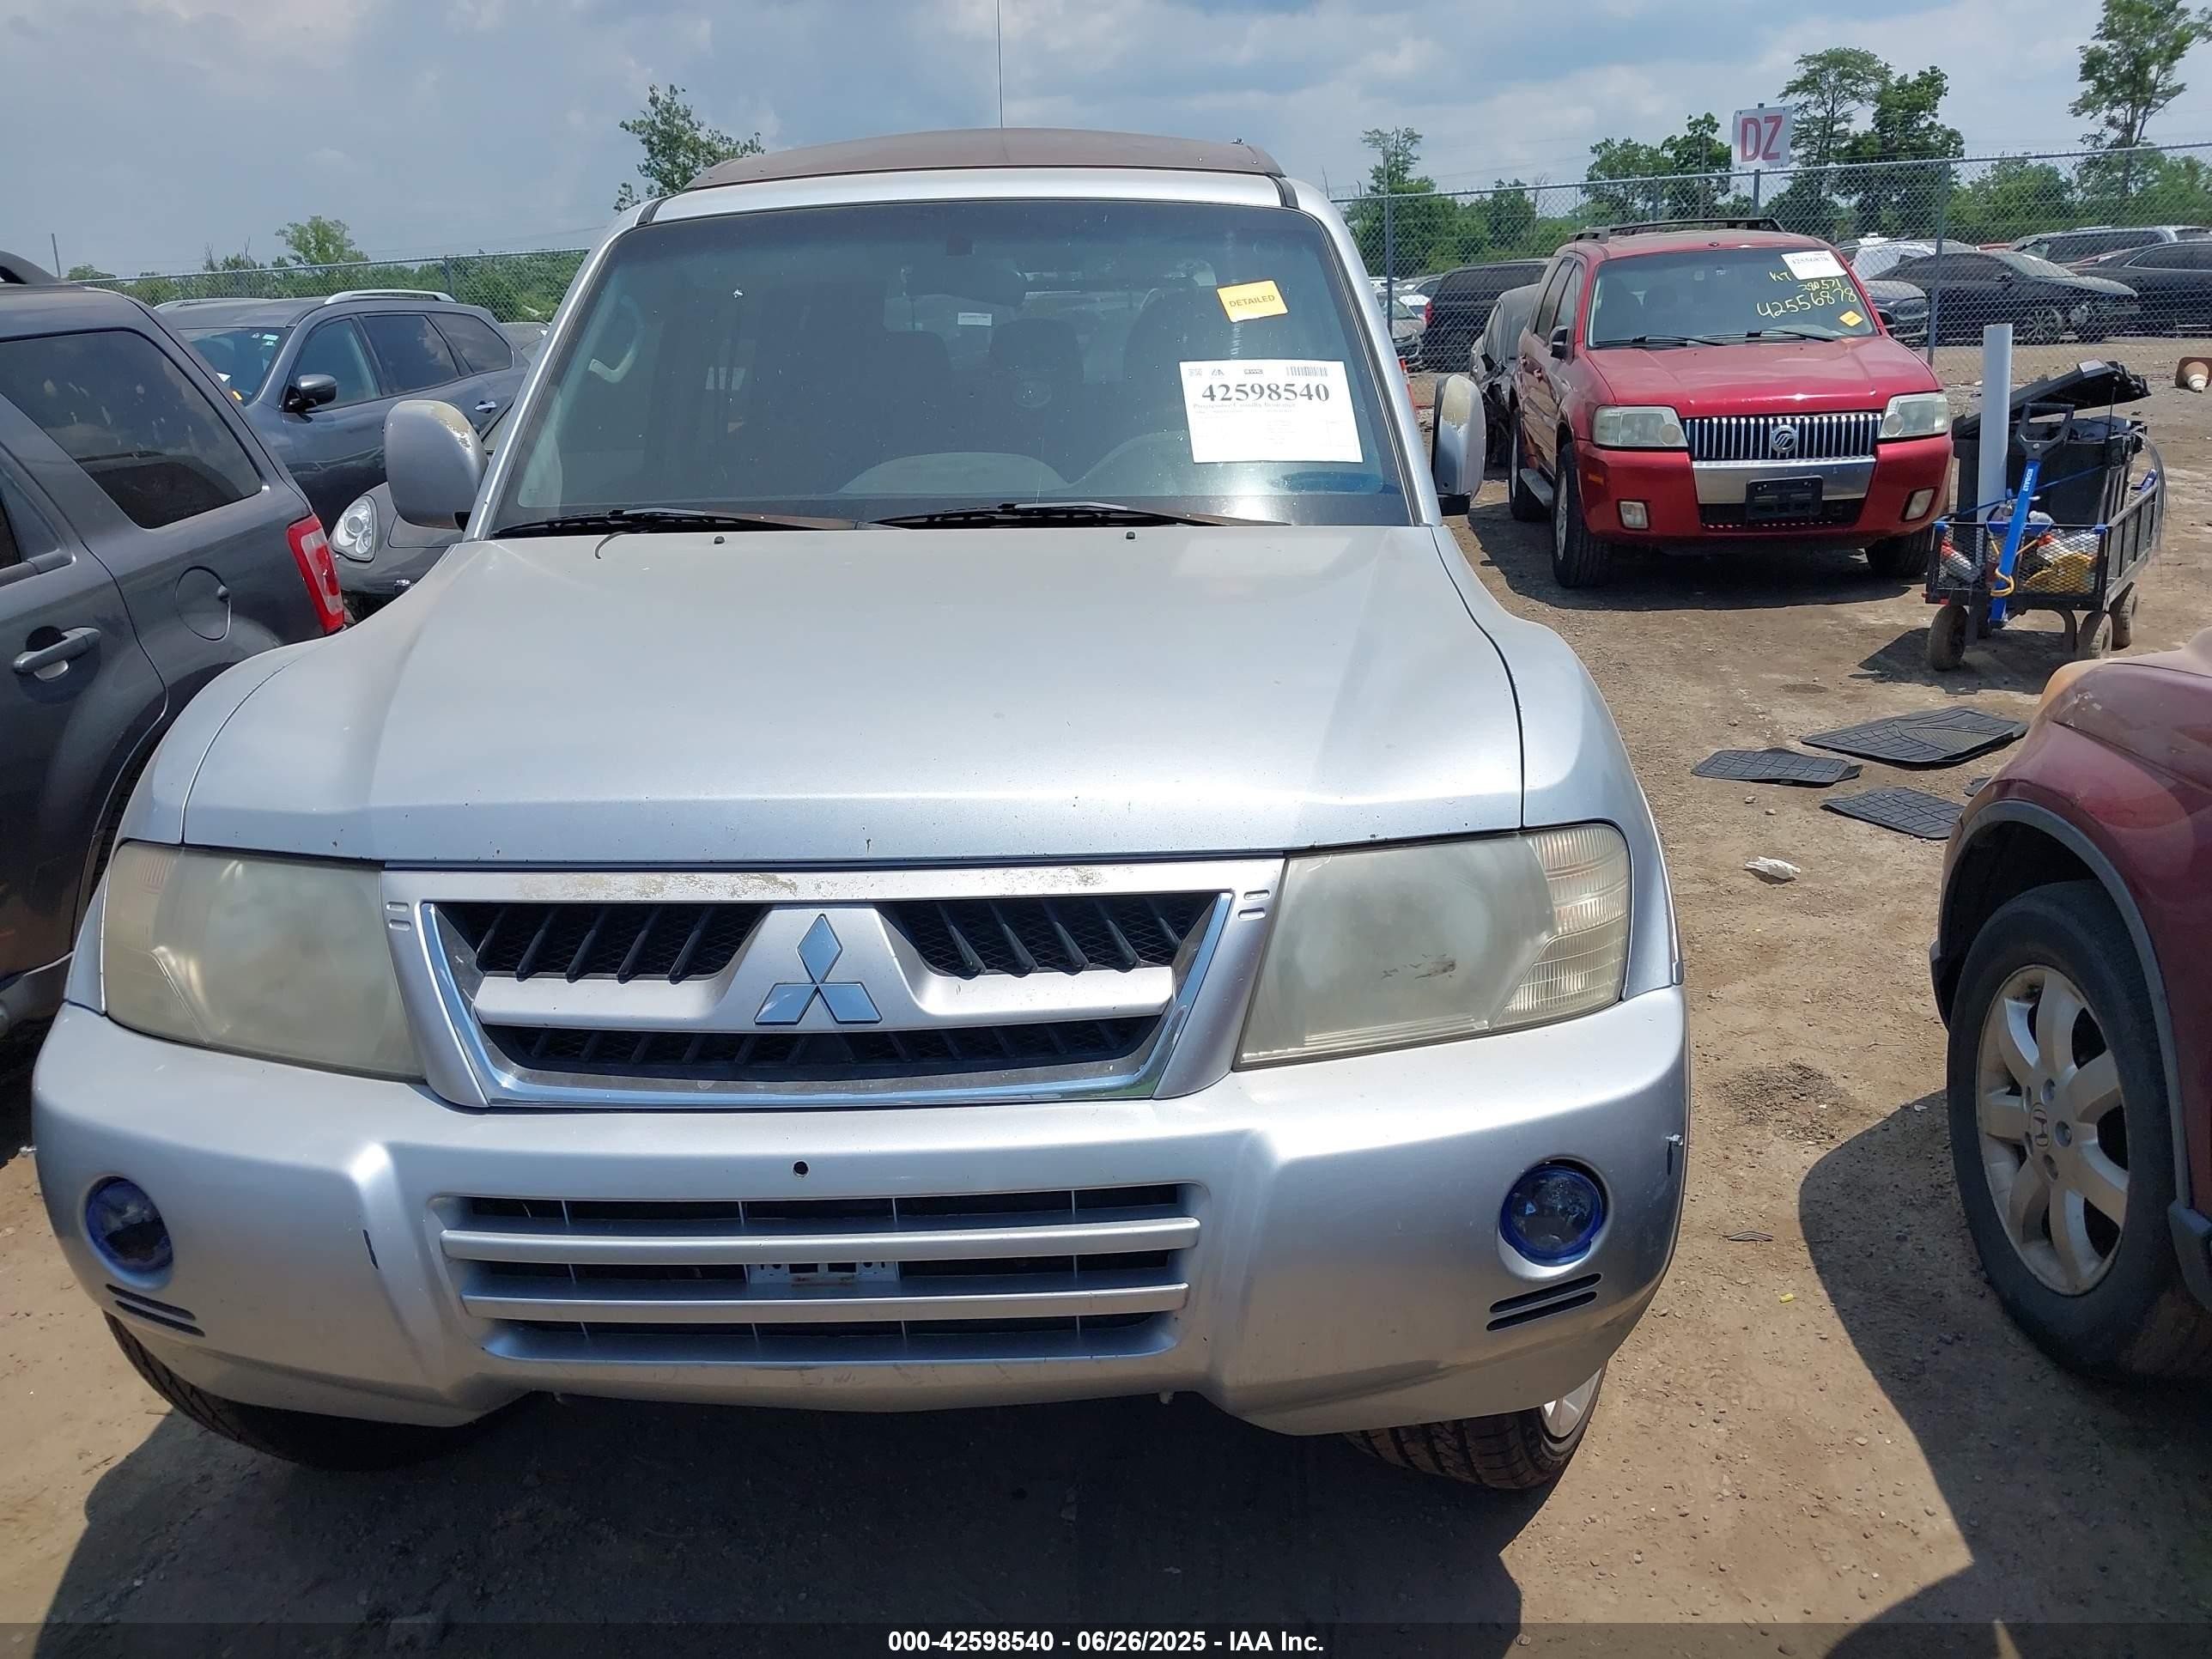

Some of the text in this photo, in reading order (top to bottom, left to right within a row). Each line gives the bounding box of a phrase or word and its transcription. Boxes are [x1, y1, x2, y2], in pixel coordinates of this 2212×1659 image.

[1741, 115, 1783, 161] DZ
[1229, 295, 1274, 307] DETAILED
[1756, 287, 1857, 319] 42556878
[1201, 383, 1329, 402] 42598540
